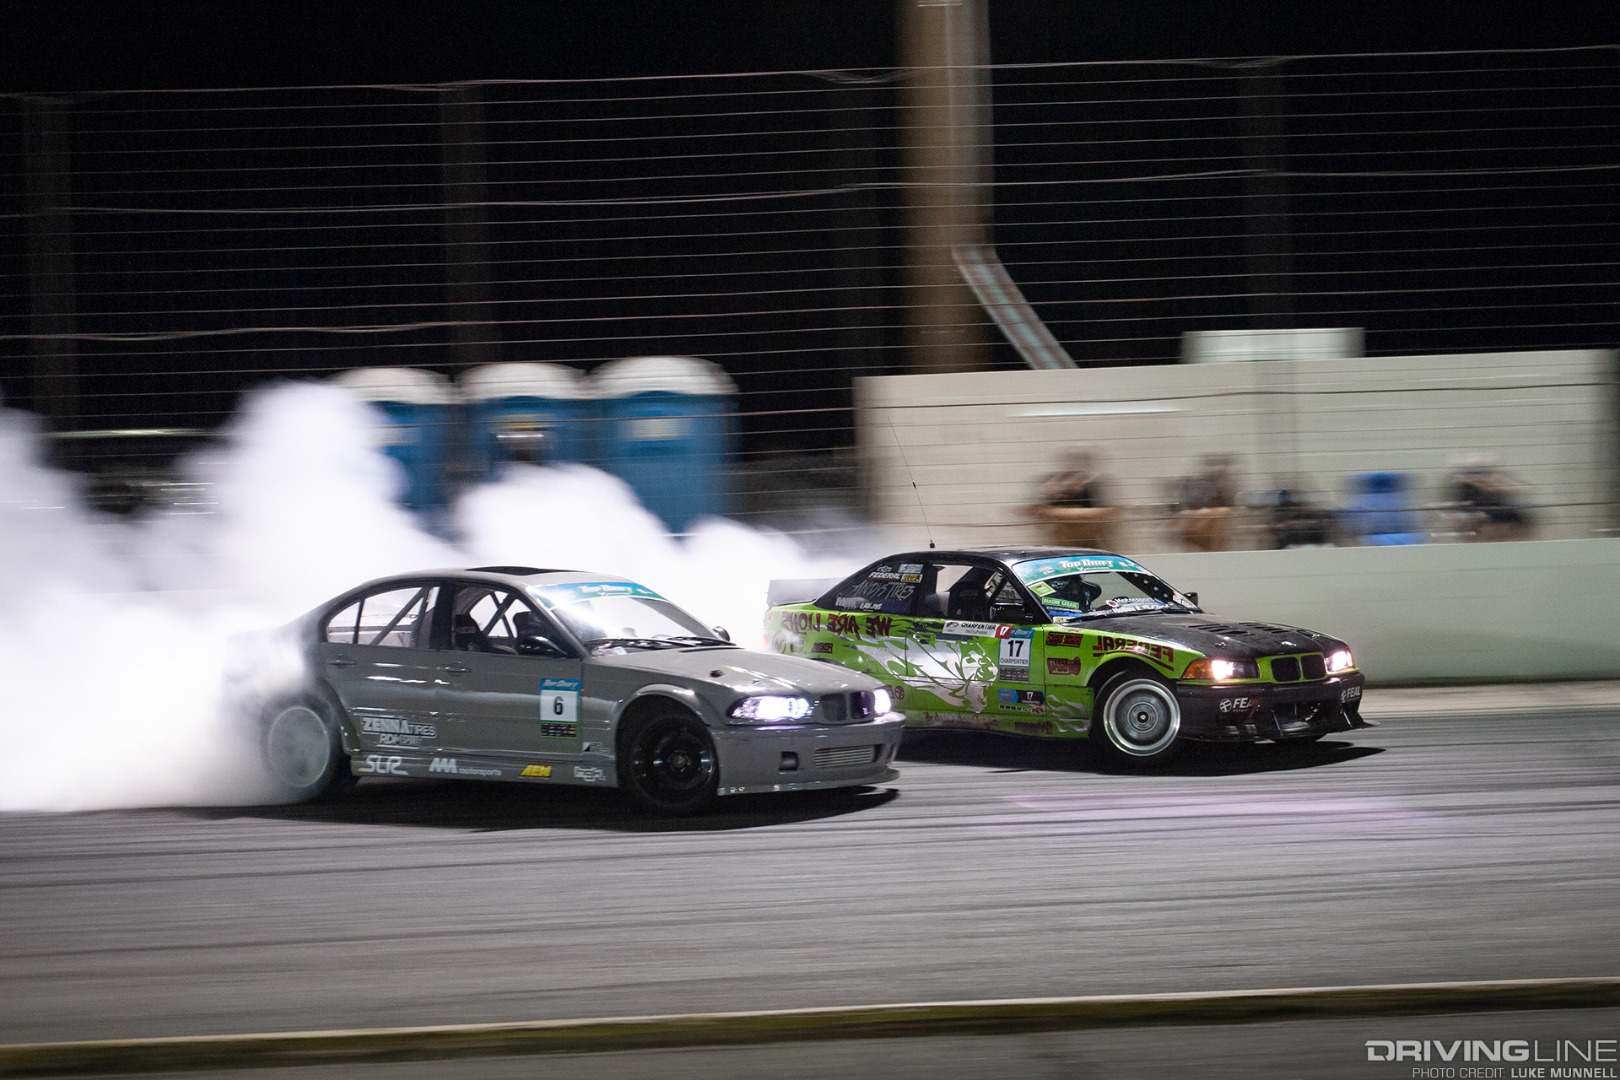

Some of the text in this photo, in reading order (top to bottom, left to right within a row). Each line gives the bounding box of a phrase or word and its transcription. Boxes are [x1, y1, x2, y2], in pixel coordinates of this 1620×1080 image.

[868, 571, 900, 579] FEDERAL
[961, 621, 997, 630] CHARPENTIER
[1007, 640, 1024, 657] 17
[1026, 691, 1034, 701] 17
[1346, 685, 1361, 699] FEAL
[554, 696, 564, 715] 6
[362, 717, 410, 734] ZENNA
[358, 755, 409, 775] SLR
[519, 764, 552, 777] AEM
